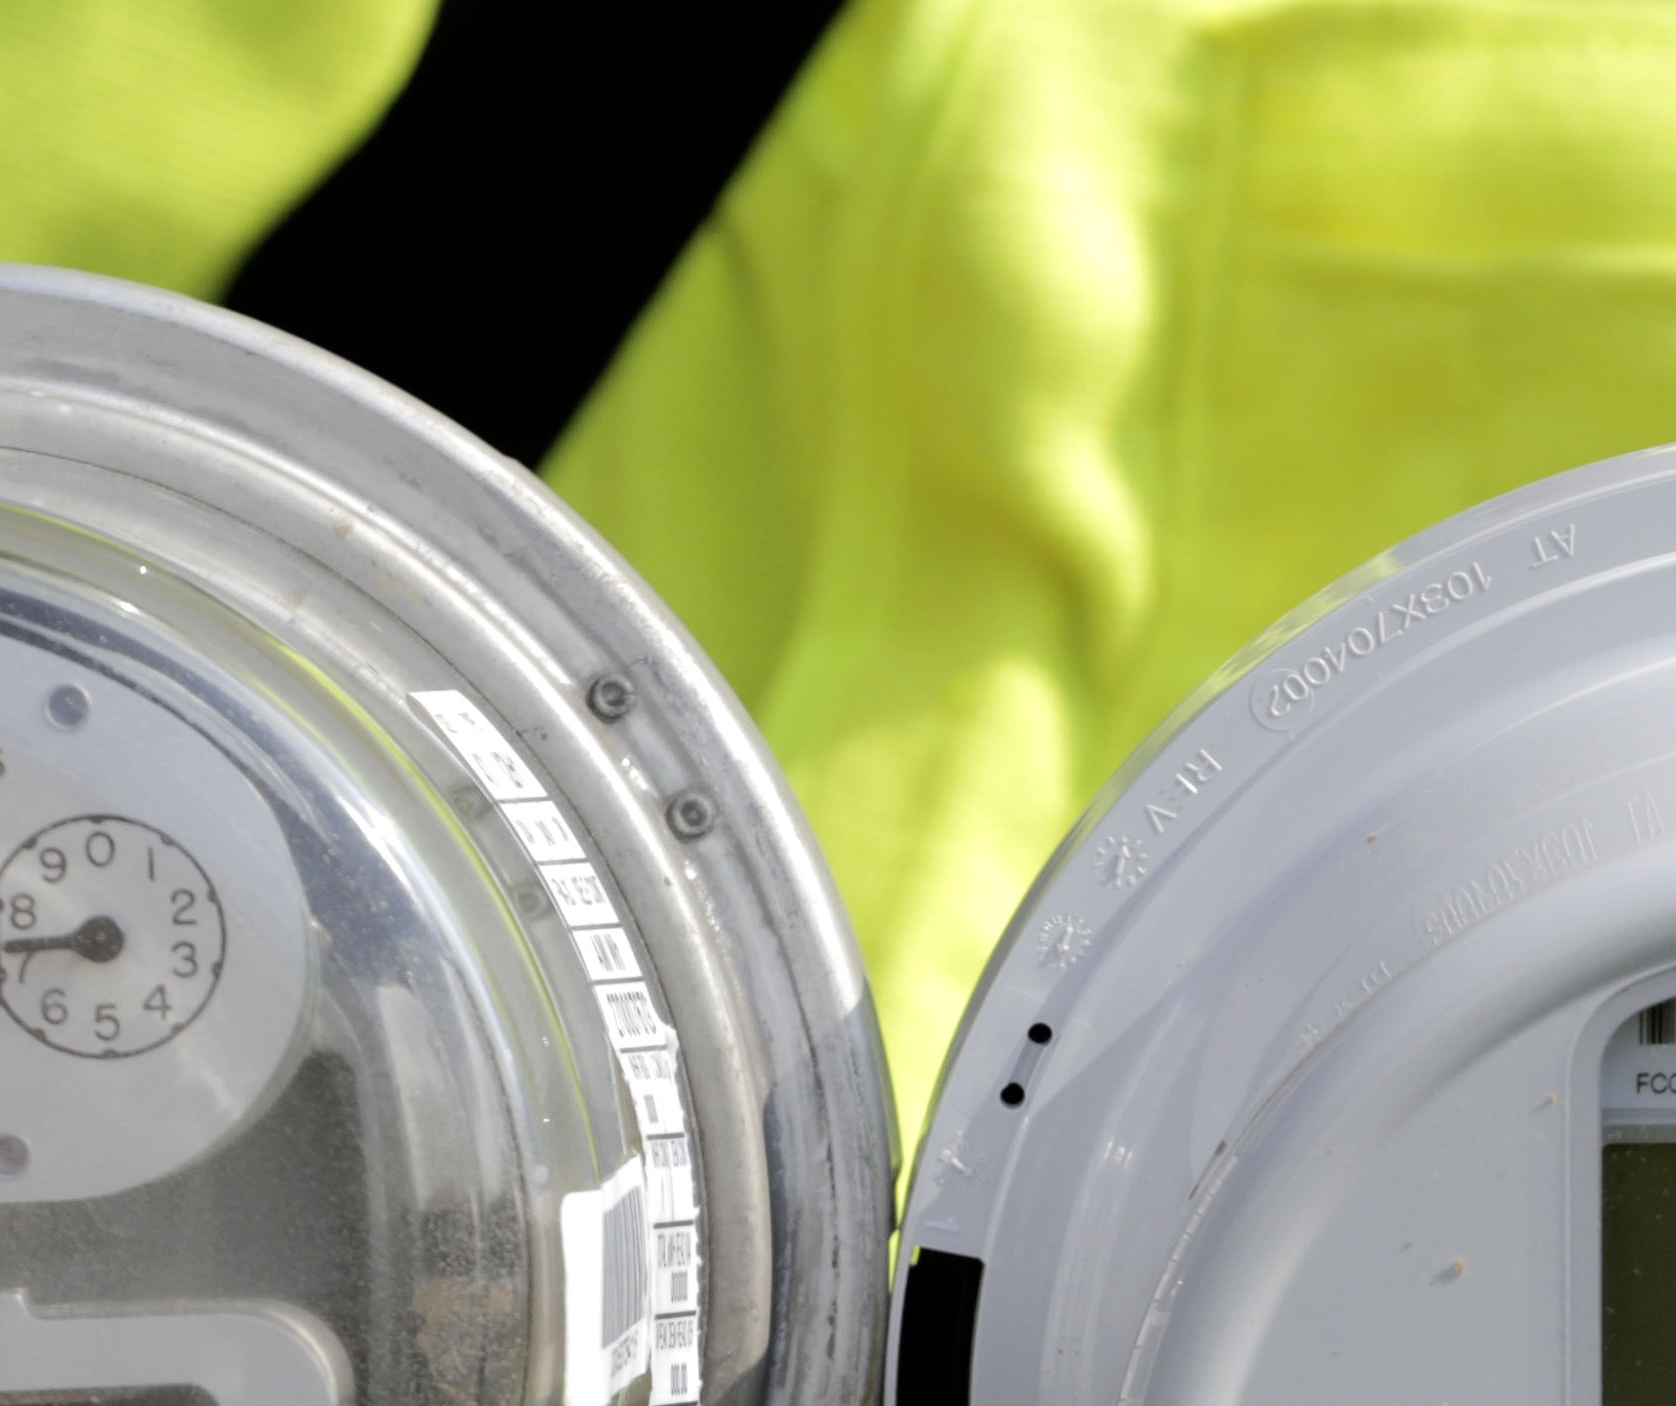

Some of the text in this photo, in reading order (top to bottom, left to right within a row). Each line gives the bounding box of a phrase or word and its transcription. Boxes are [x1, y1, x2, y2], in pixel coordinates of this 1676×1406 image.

[39, 847, 67, 884] 9
[85, 831, 116, 868] 0
[9, 893, 36, 930] 8
[170, 888, 198, 926] 2
[172, 941, 199, 978] 3
[41, 987, 68, 1025] 6
[143, 984, 172, 1020] 4
[94, 1004, 121, 1041] 5
